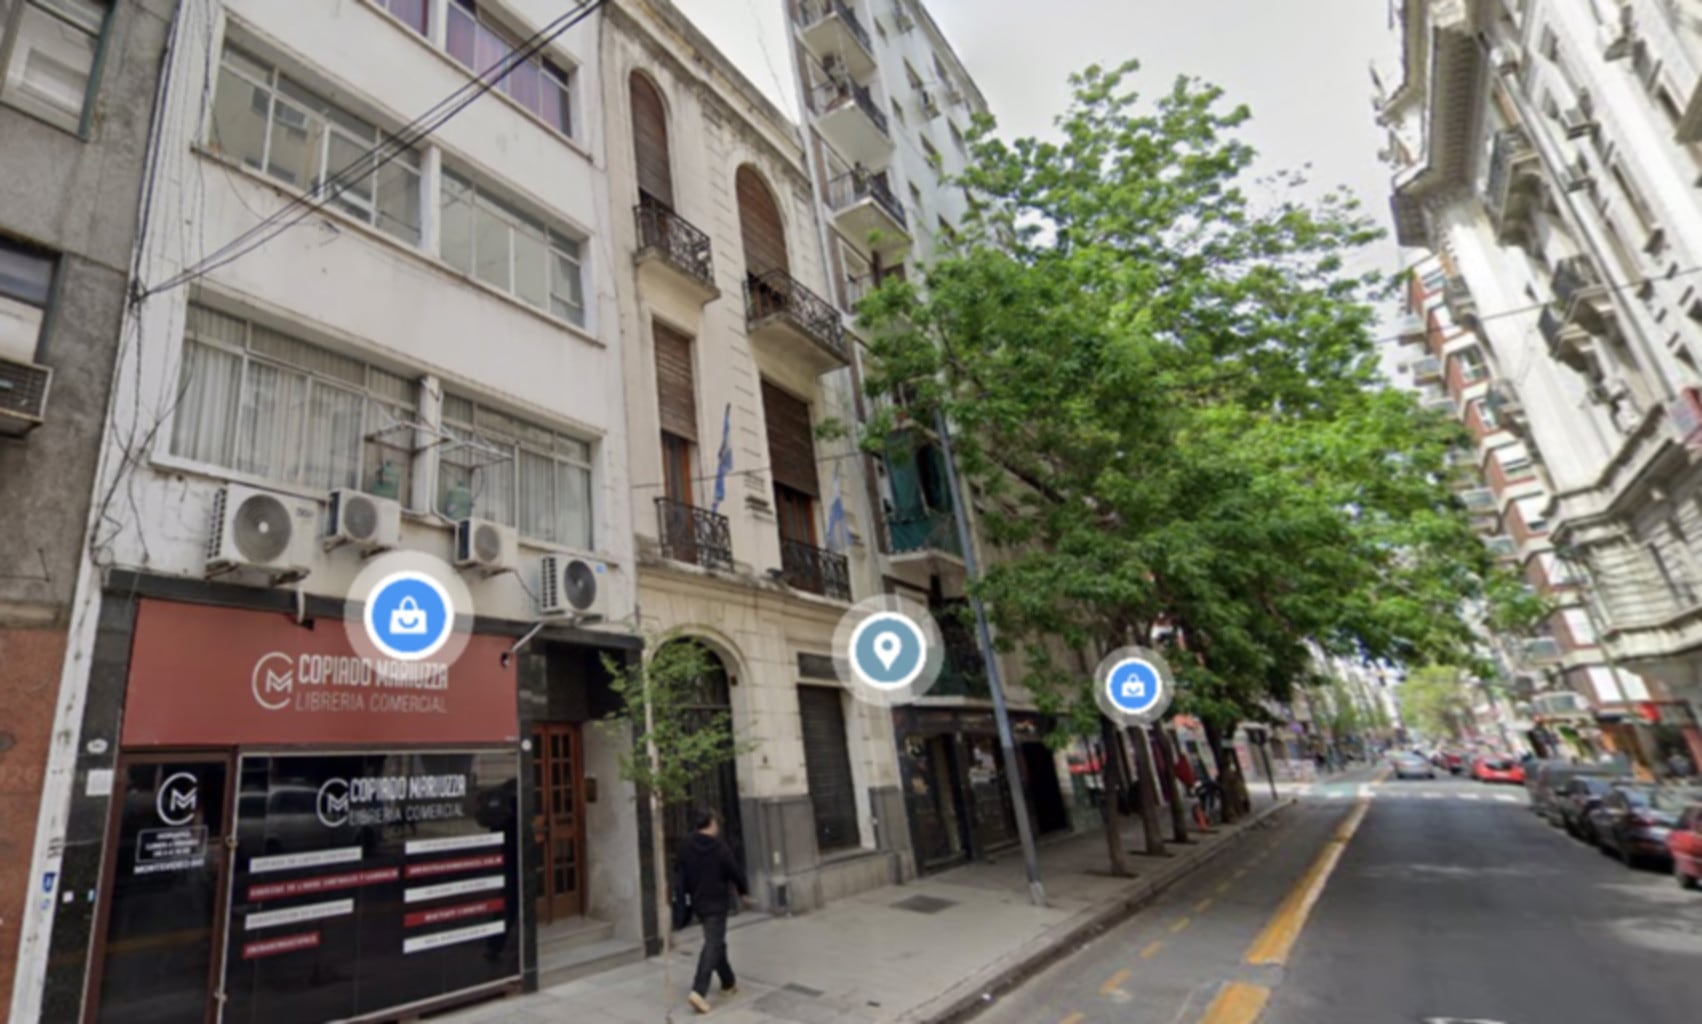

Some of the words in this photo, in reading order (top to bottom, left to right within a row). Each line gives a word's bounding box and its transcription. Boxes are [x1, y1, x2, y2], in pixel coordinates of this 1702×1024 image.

[298, 654, 371, 687] COPIADO
[296, 691, 365, 713] LIBRERIA
[370, 693, 449, 714] COMERCIAL
[350, 776, 407, 803] COPIADO
